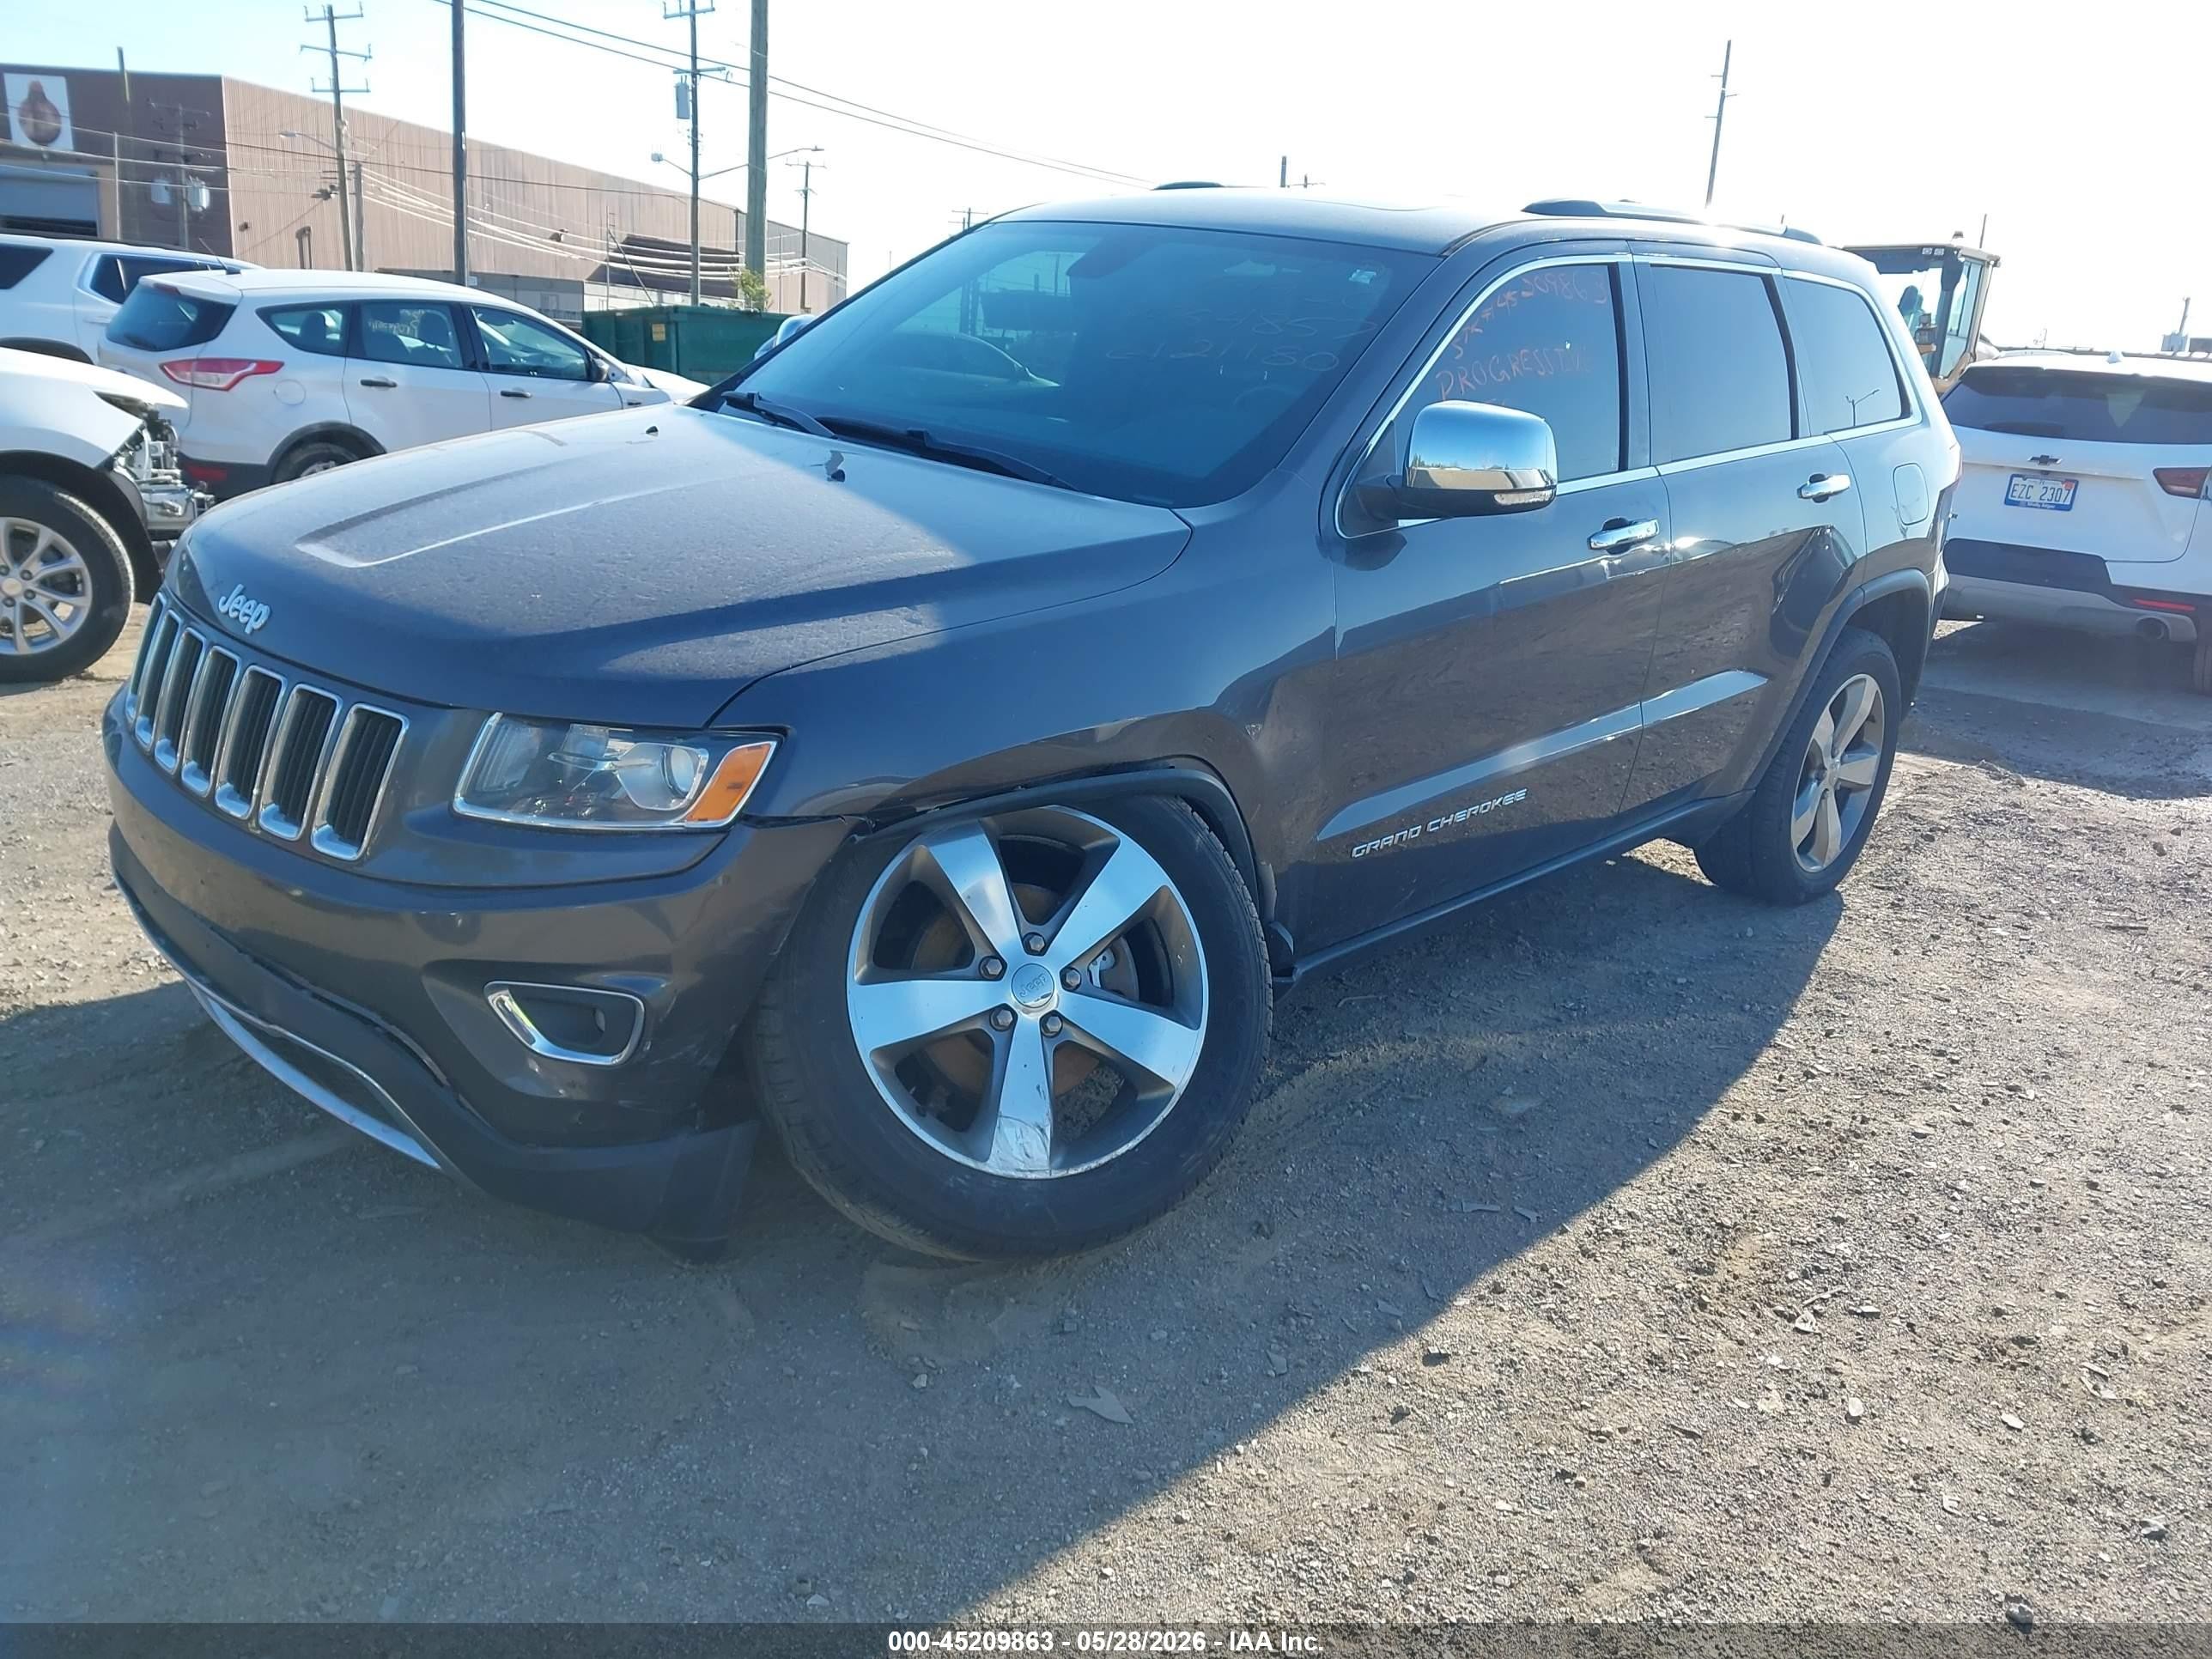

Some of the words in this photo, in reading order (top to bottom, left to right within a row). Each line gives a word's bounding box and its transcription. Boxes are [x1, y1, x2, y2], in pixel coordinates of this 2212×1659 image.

[2010, 483, 2034, 500] EZC
[2039, 486, 2071, 503] 2307
[218, 583, 271, 635] Jeep
[1351, 825, 1423, 859] GRAND
[1425, 787, 1528, 832] CHEROKEE
[1018, 971, 1048, 998] Jeep
